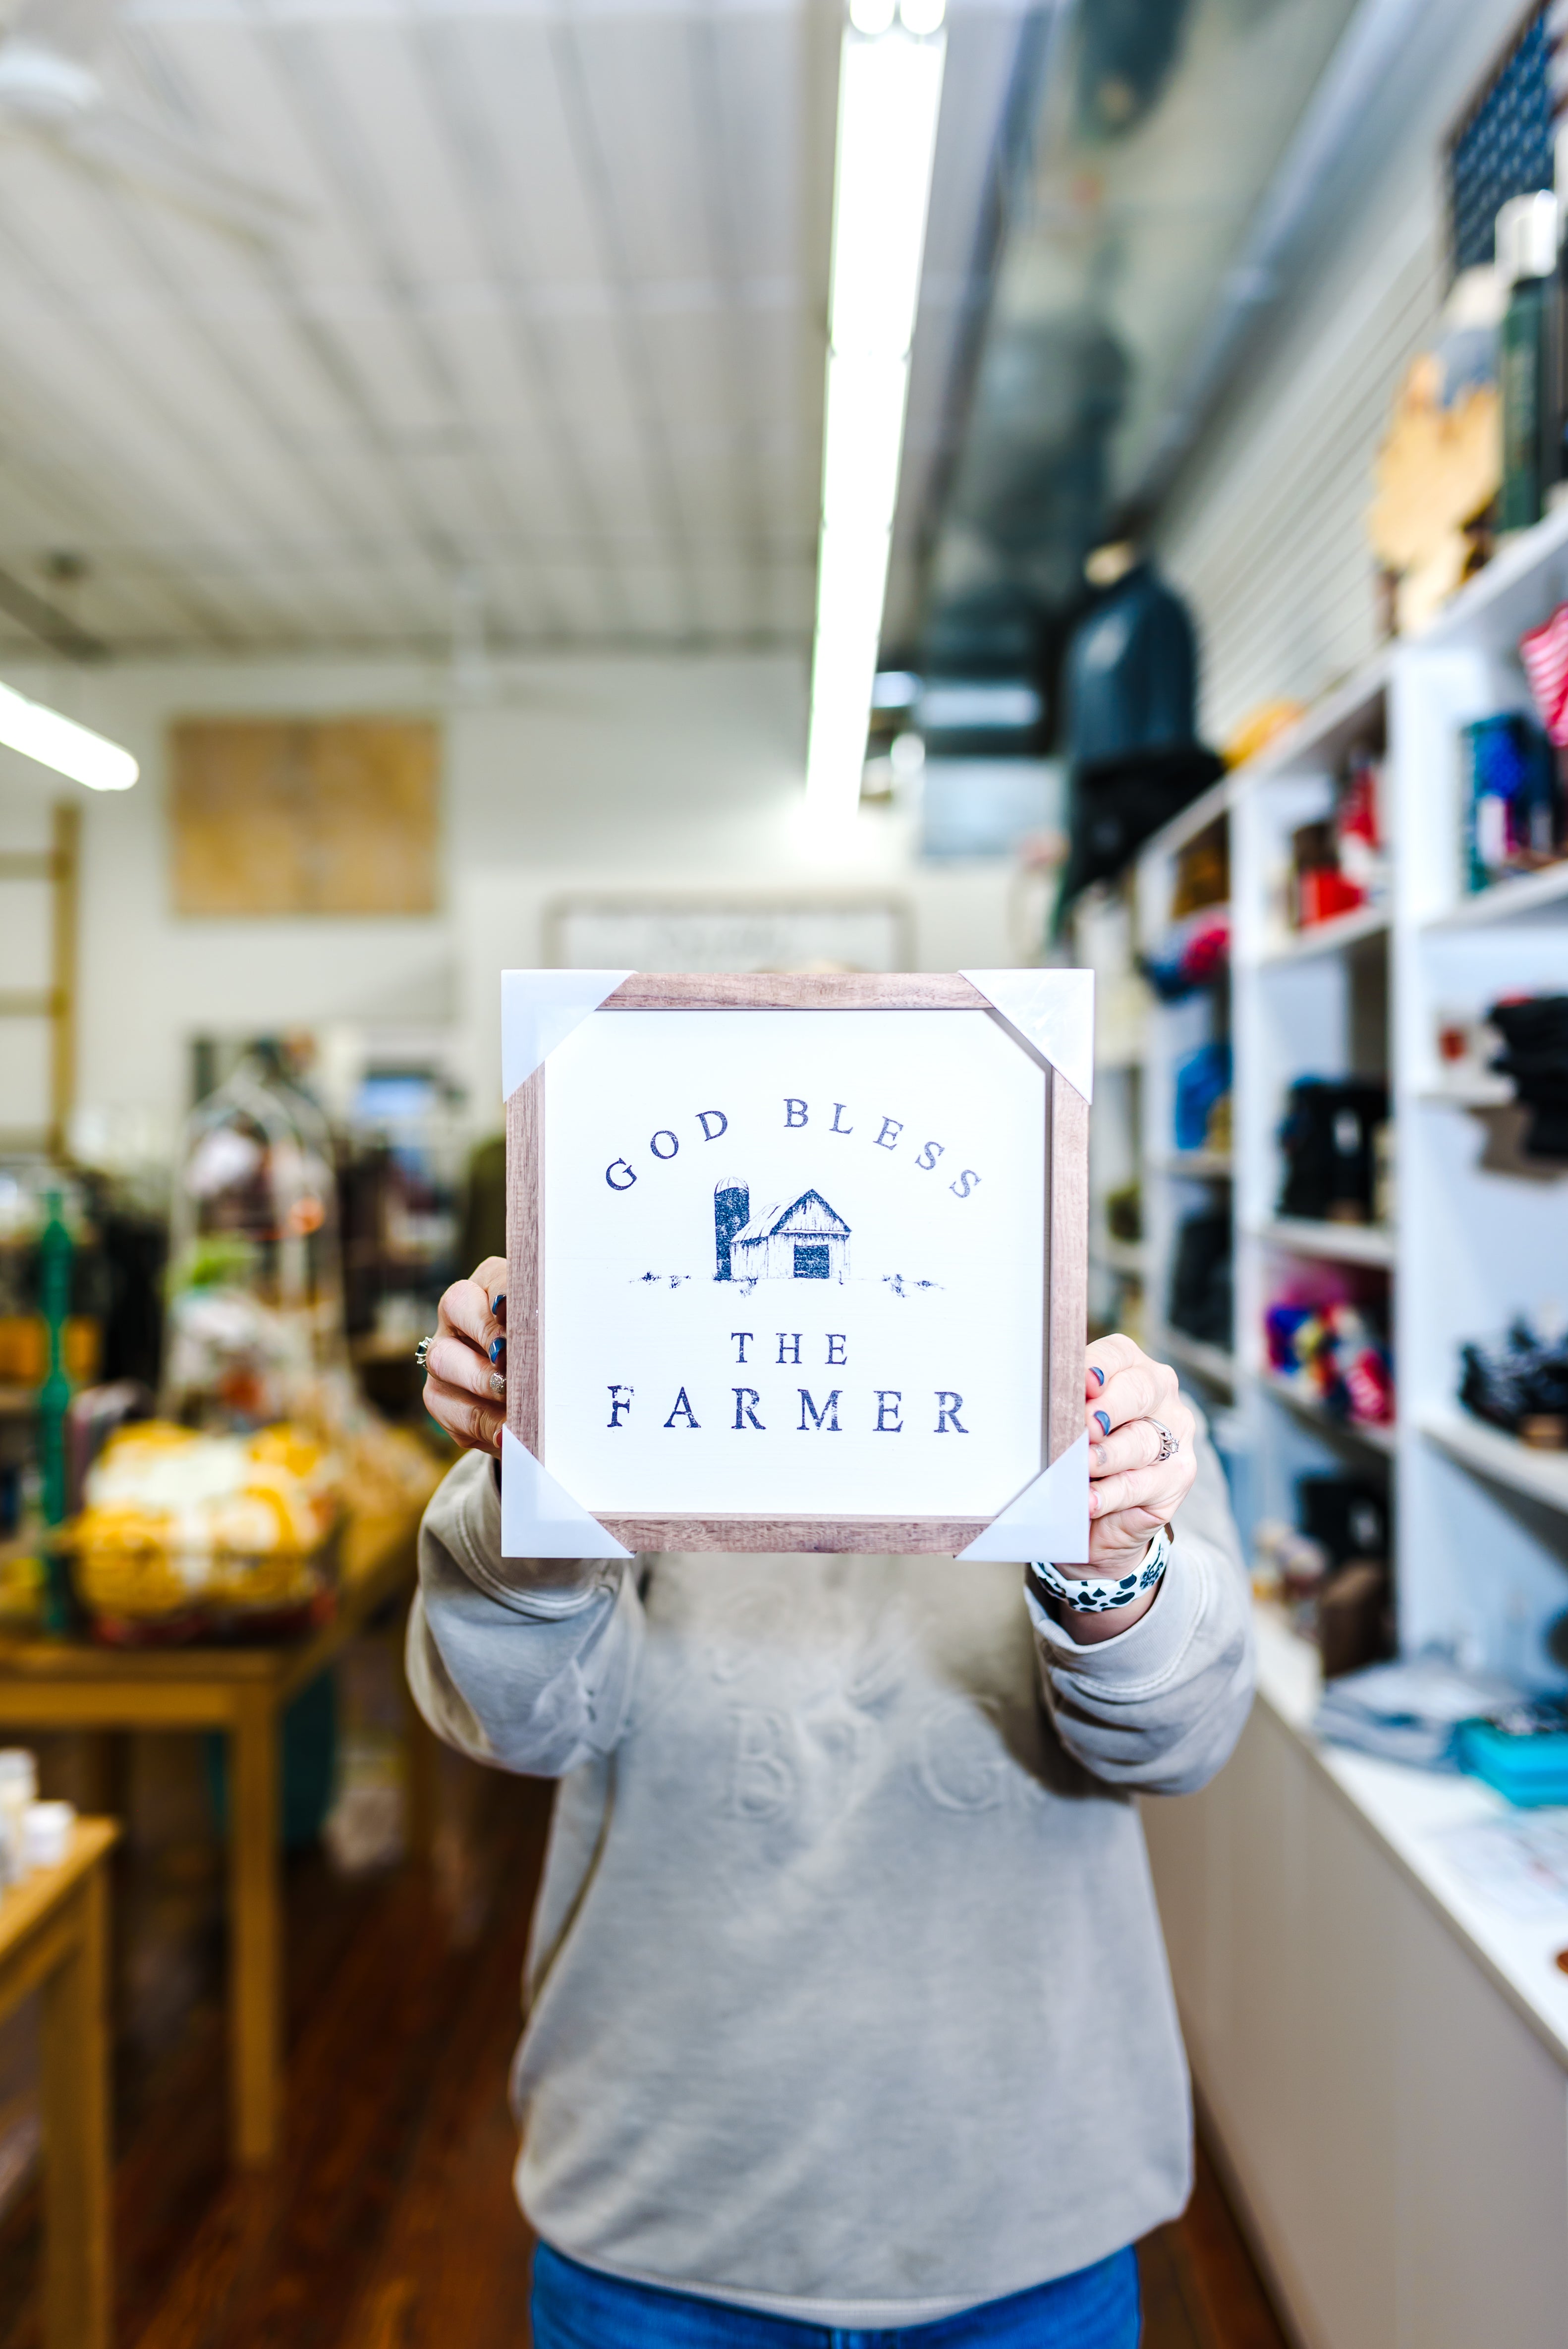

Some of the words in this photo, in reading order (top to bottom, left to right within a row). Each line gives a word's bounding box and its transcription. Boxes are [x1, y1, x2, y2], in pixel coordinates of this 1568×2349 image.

[605, 1110, 729, 1191] GOD
[783, 1098, 982, 1199] BLESS
[730, 1332, 848, 1366] THE
[606, 1384, 970, 1434] FARMER
